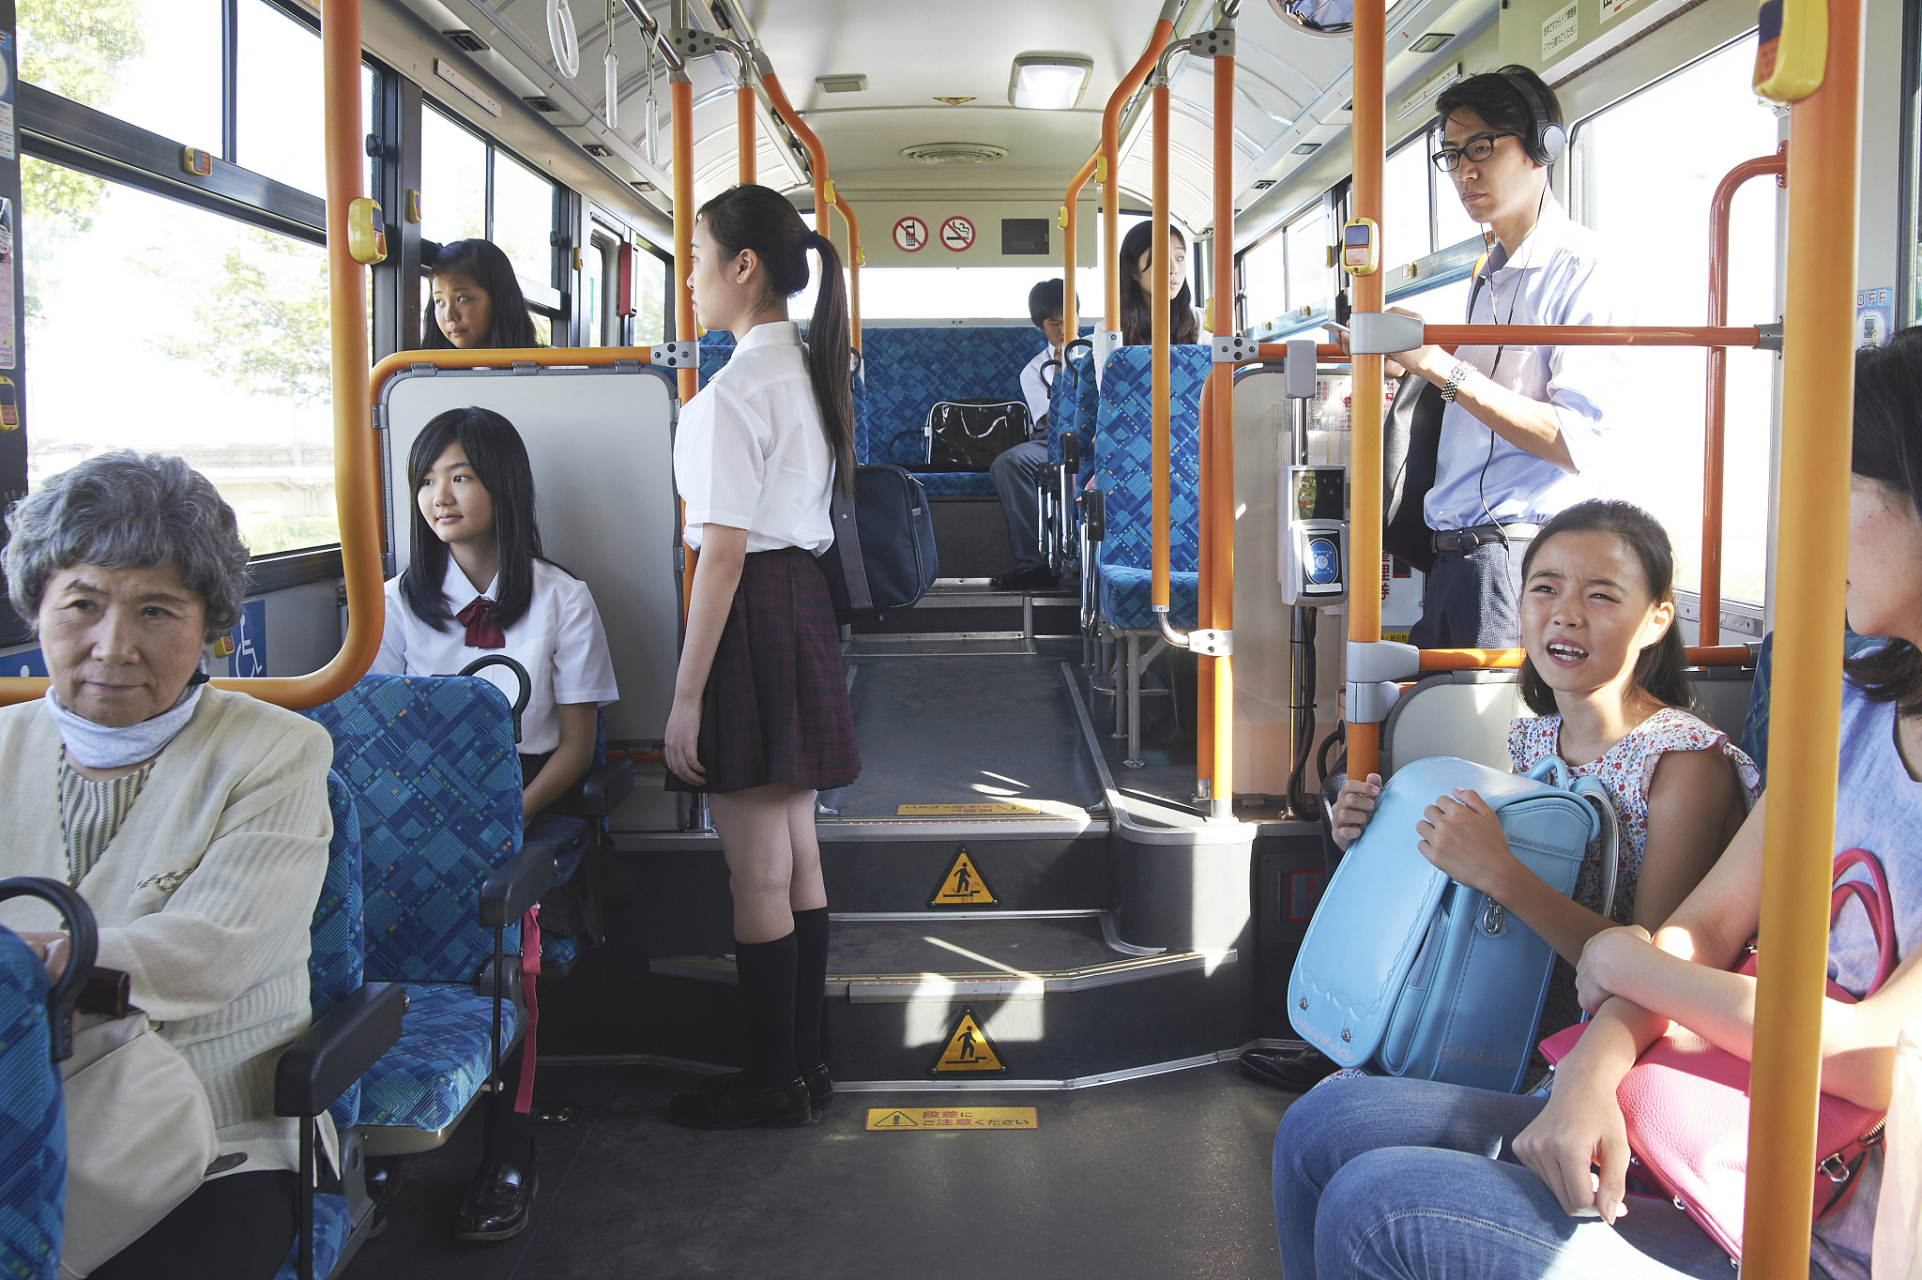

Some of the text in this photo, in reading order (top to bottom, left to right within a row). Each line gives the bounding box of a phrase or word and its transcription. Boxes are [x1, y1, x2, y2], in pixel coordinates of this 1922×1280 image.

[1856, 290, 1887, 307] OFF
[1306, 876, 1316, 917] 非常コック
[922, 1110, 973, 1118] 段差に
